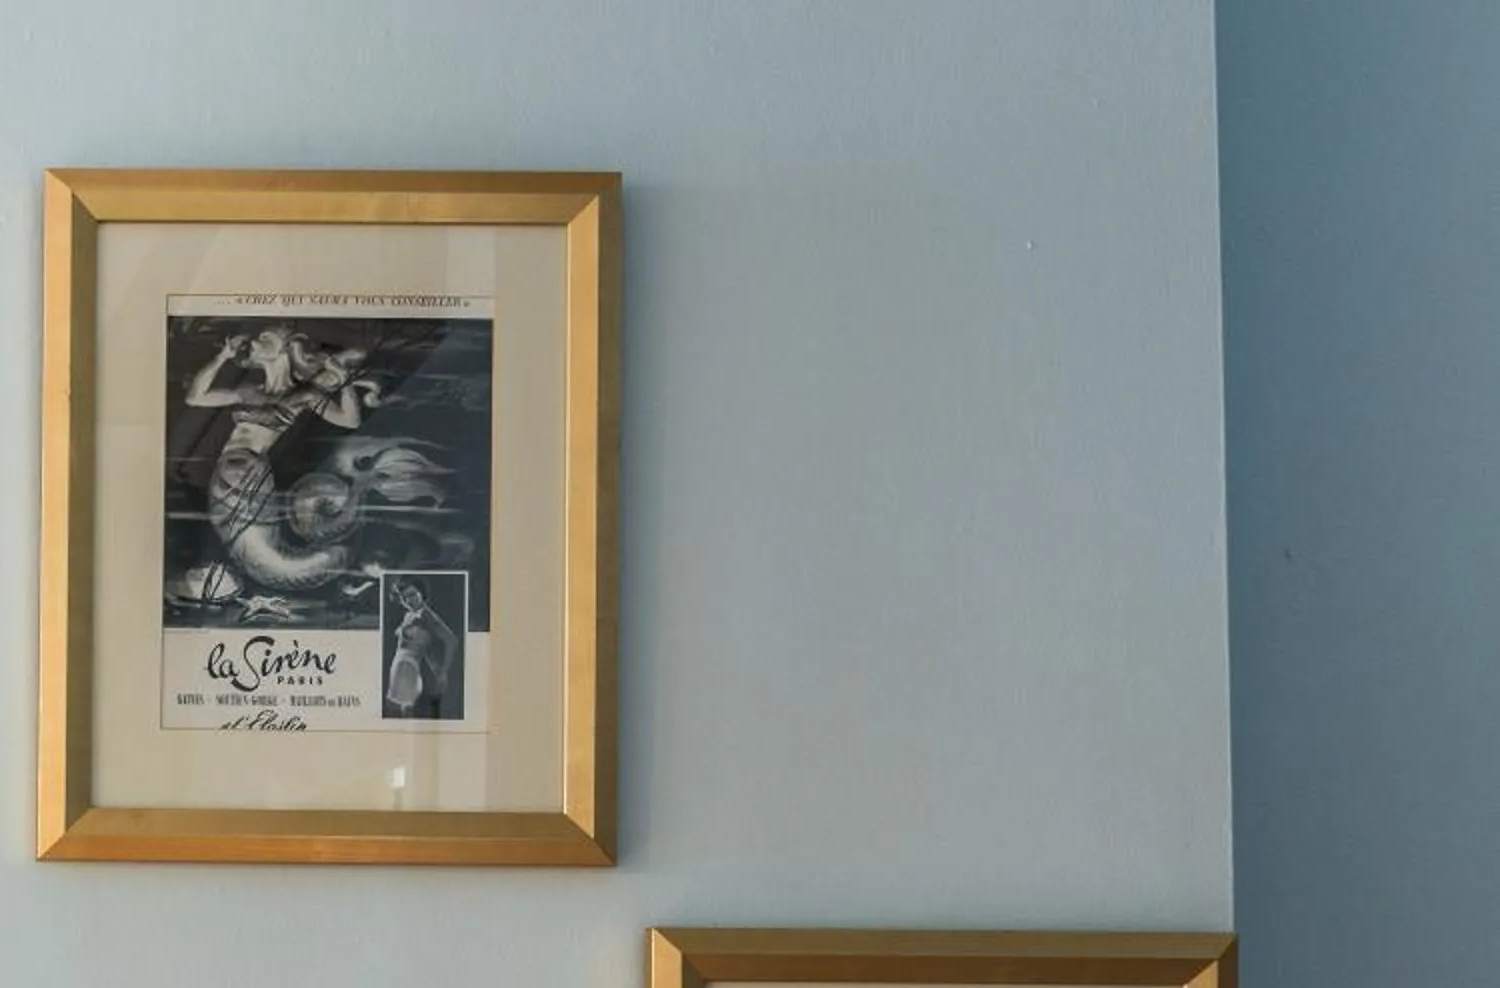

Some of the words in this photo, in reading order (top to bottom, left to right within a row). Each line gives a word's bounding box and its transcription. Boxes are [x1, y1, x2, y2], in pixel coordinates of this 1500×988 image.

[204, 642, 240, 679] la
[231, 635, 337, 692] Sirène
[276, 675, 324, 686] PARIS
